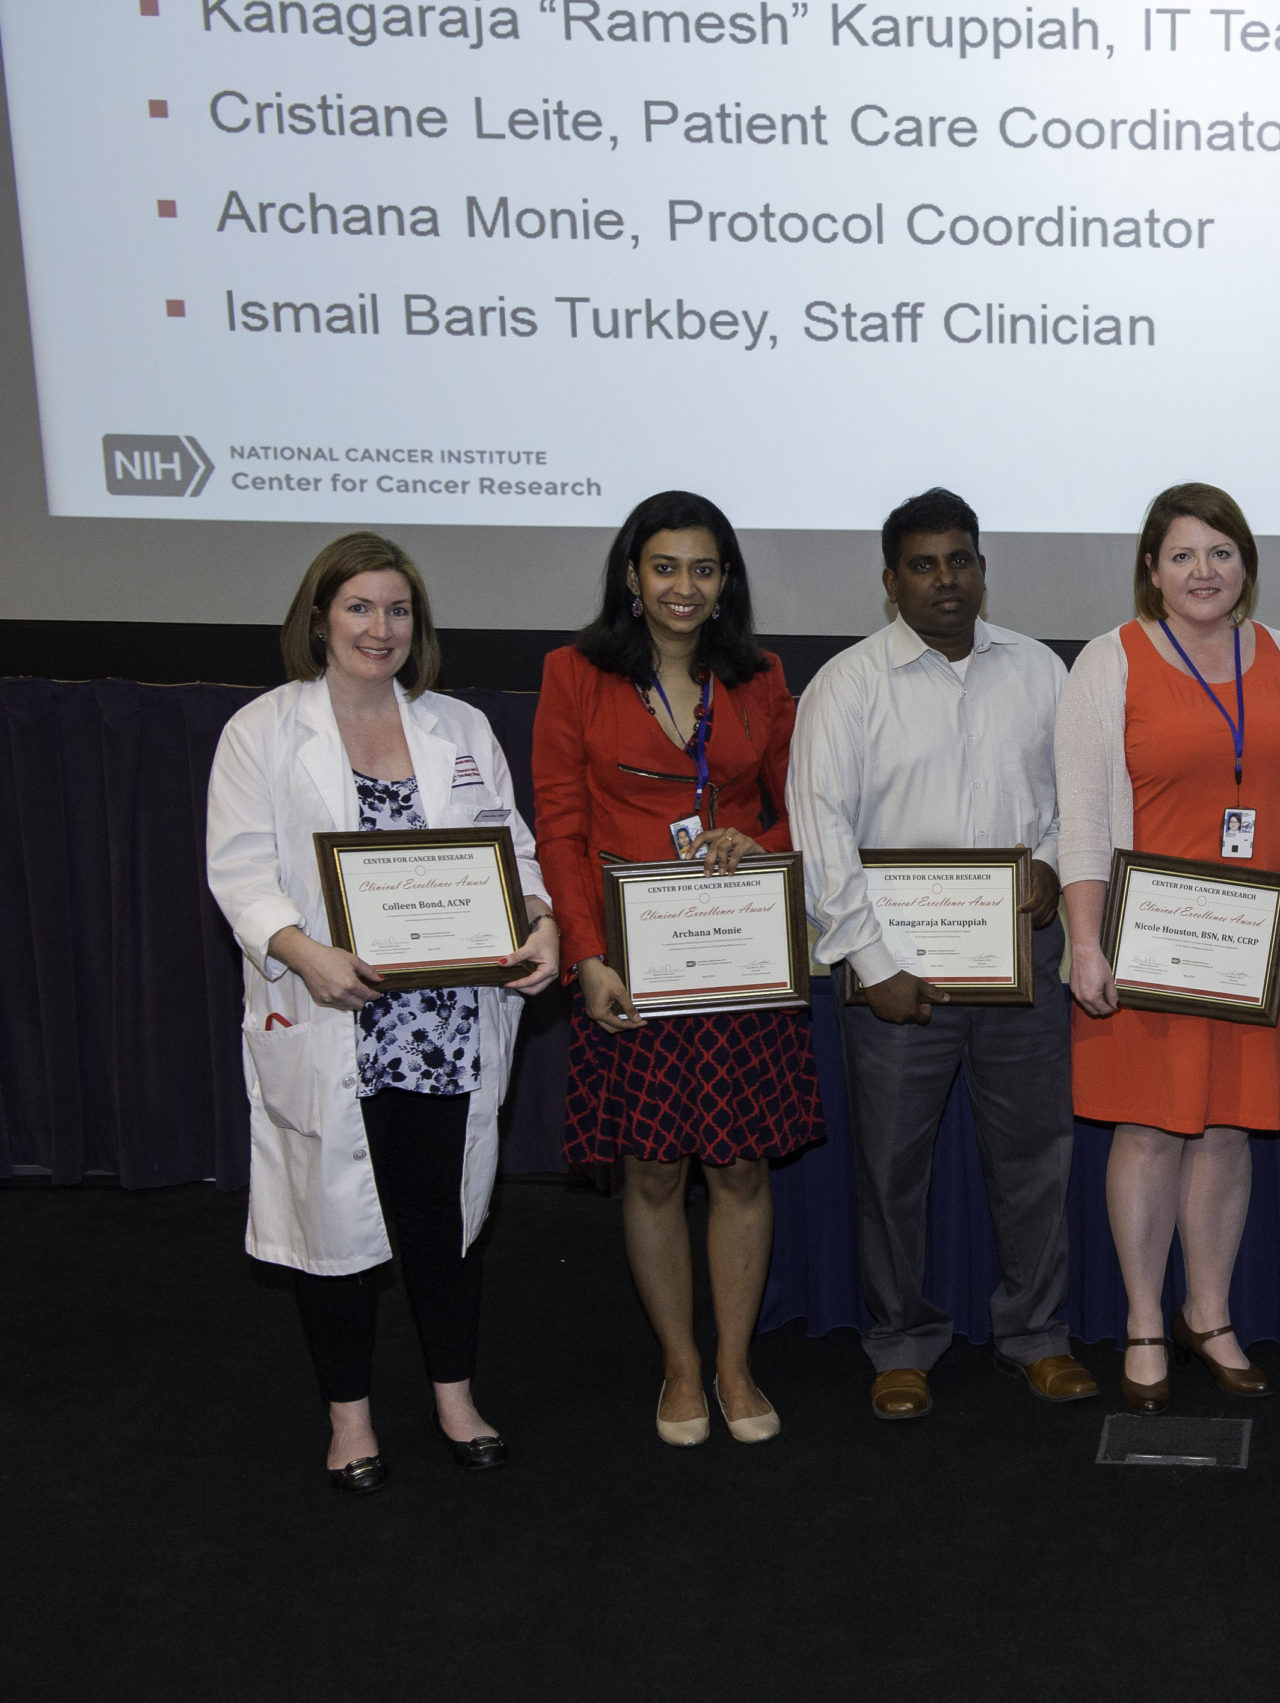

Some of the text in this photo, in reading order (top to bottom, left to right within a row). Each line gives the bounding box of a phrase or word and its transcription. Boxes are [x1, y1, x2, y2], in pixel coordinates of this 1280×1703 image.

[201, 0, 521, 50] Kanagaraja
[538, 0, 810, 46] “Ramesh”
[830, 3, 1114, 60] Karuppiah,
[1145, 8, 1191, 51] IT
[208, 90, 448, 139] Cristiane
[474, 96, 620, 151] Leite,
[644, 100, 828, 146] Patient
[850, 104, 979, 148] Care
[217, 191, 1215, 250] Archana Monie, Protocol Coordinator
[227, 289, 1156, 351] Ismail Baris Turkbey, Staff Clinician
[230, 445, 548, 465] NATIONAL CANCER INSTITUTE
[114, 452, 183, 482] NIH
[231, 471, 602, 497] Center for Cancer Research
[363, 857, 392, 865] CENTER
[409, 855, 436, 863] CANCER
[437, 853, 473, 862] RESEARCH
[359, 875, 491, 893] Clinical Excellence Award
[648, 886, 676, 894] CENTER
[694, 883, 722, 891] CANCER
[724, 880, 761, 889] RESEARCH
[1152, 880, 1256, 900] CENTER FOR CANCER RESEARCH
[382, 898, 471, 911] Colleen Bond, ACNP
[876, 895, 1004, 907] Clinical Excellence Award
[639, 902, 776, 921] Clinical Excellence Award
[1139, 901, 1266, 927] Clinical Excellence Award
[672, 927, 742, 938] Archana Monie
[889, 918, 987, 928] Kanagaraja Karuppiah
[1134, 922, 1160, 932] Nicole
[1162, 926, 1199, 939] Houston,
[1201, 931, 1219, 941] BSN,
[1221, 934, 1235, 943] RN,
[1237, 936, 1259, 946] CCRP
